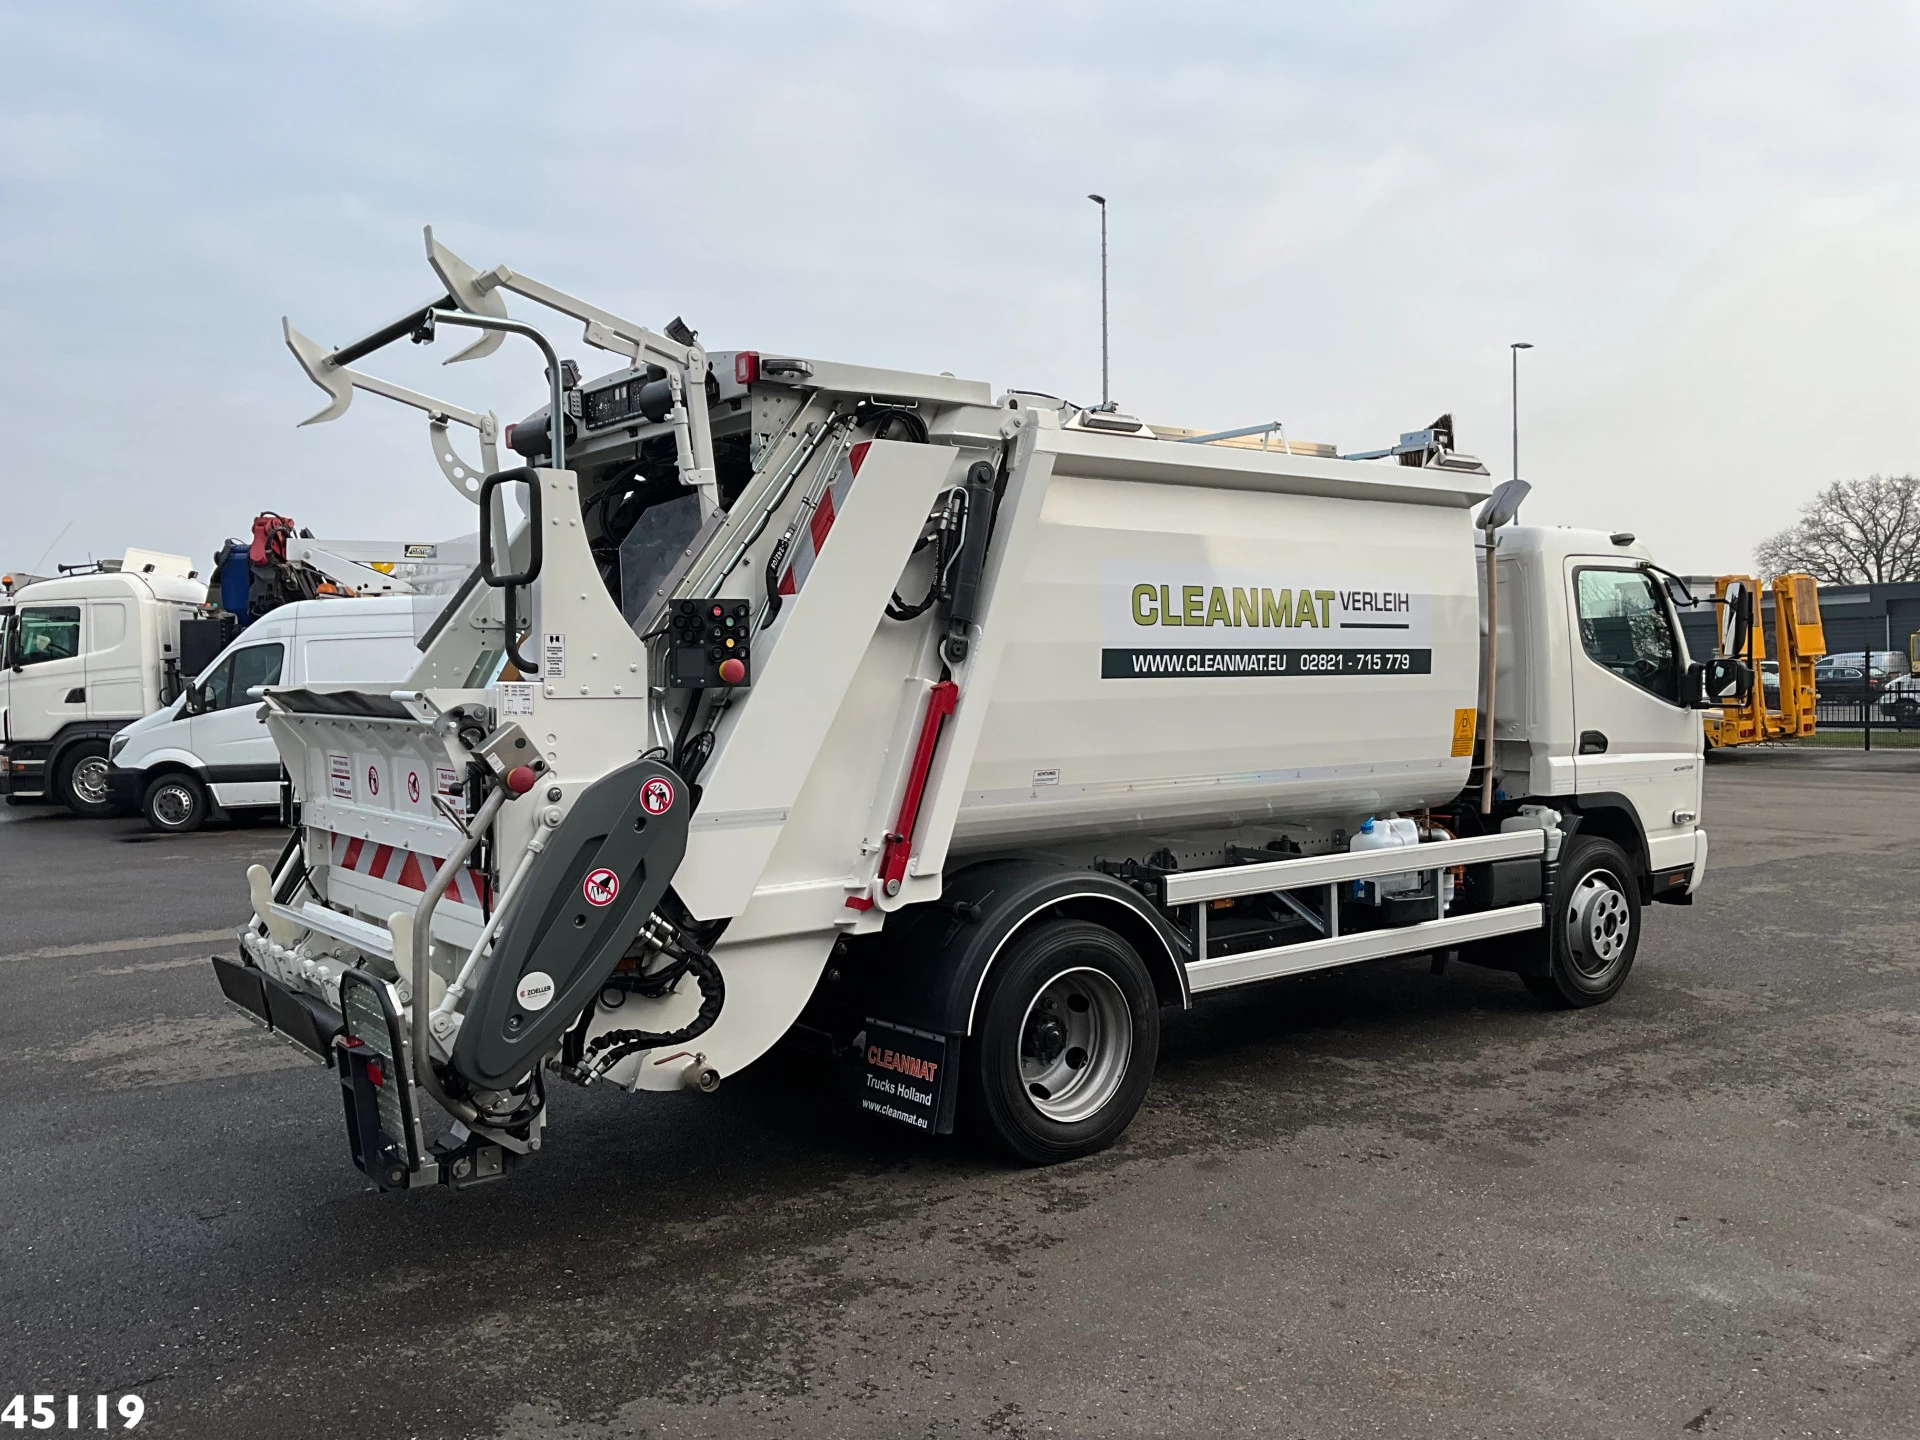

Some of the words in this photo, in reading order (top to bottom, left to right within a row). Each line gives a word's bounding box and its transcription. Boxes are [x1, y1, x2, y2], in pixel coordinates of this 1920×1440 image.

[1131, 584, 1335, 628] CLEANMAT
[1340, 590, 1409, 612] VERLEIH
[1132, 654, 1287, 672] WWW.CLEANMAT.EU
[1300, 654, 1343, 670] 02821
[1356, 653, 1382, 670] 715
[1385, 653, 1410, 669] 779
[528, 986, 551, 995] ZOELLER
[868, 1046, 937, 1082] CLEANMAT
[866, 1073, 895, 1094] Trucks
[897, 1083, 932, 1106] Holland
[862, 1098, 928, 1129] www.cleanmat.eu
